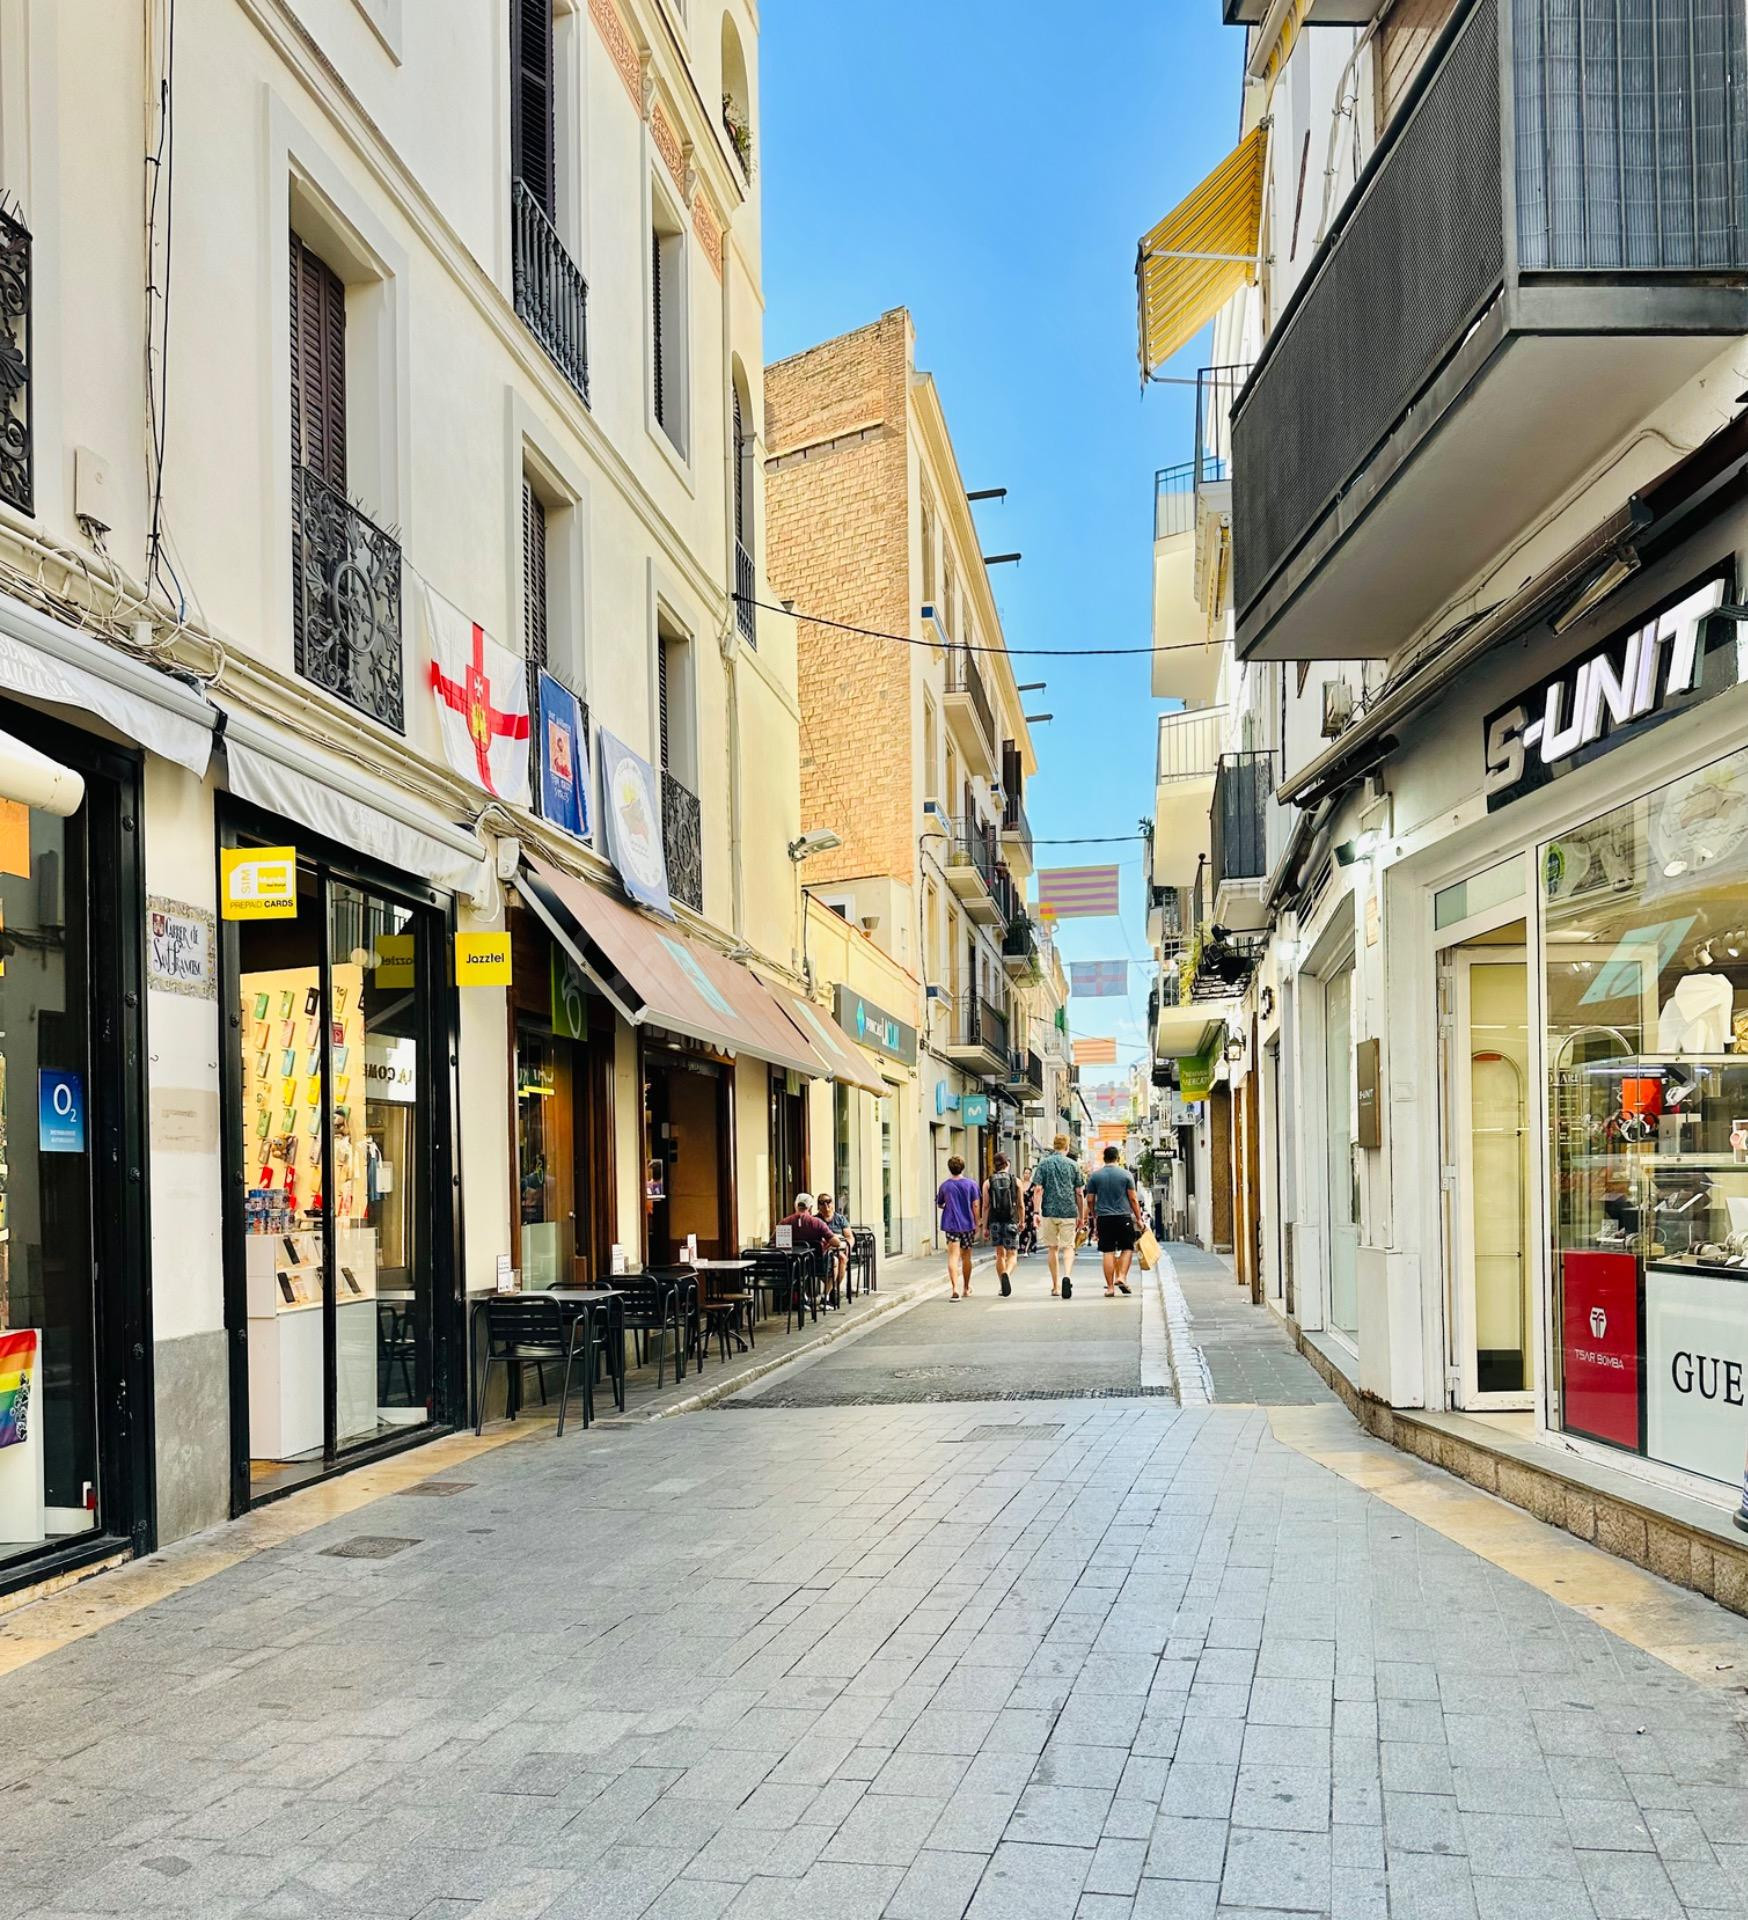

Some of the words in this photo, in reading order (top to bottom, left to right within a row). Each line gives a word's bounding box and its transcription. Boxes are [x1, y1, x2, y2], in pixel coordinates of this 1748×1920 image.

[1484, 579, 1725, 796] S-UNIT
[241, 869, 252, 894] SIM
[230, 901, 262, 909] PREPAID
[264, 900, 293, 908] CARDS
[466, 953, 505, 964] Jazztel
[1574, 1348, 1596, 1363] TSAR
[1597, 1353, 1625, 1370] BOMBA
